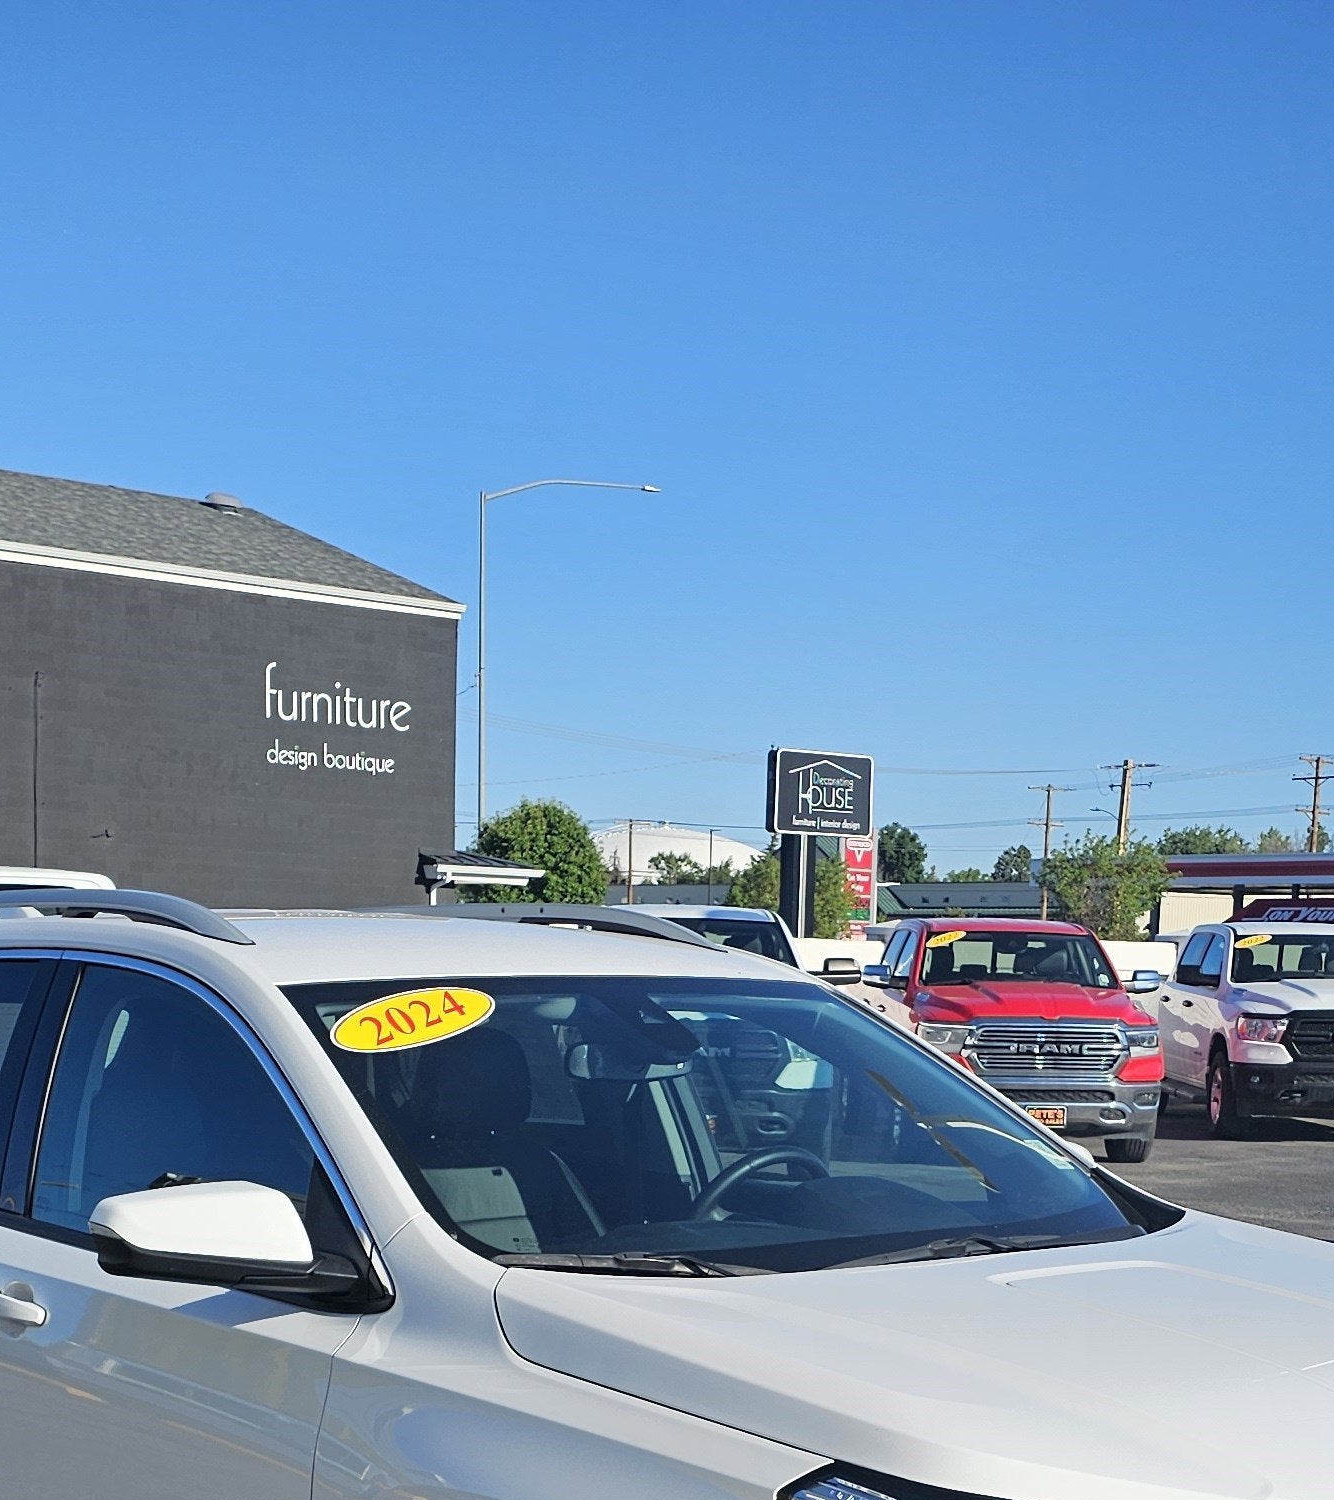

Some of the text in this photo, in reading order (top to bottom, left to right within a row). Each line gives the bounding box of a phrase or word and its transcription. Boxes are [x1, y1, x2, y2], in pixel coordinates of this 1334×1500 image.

[265, 661, 412, 732] furniture
[266, 738, 395, 776] design boutique
[842, 818, 861, 831] design
[359, 990, 465, 1046] 2024
[1018, 1043, 1080, 1054] RAM
